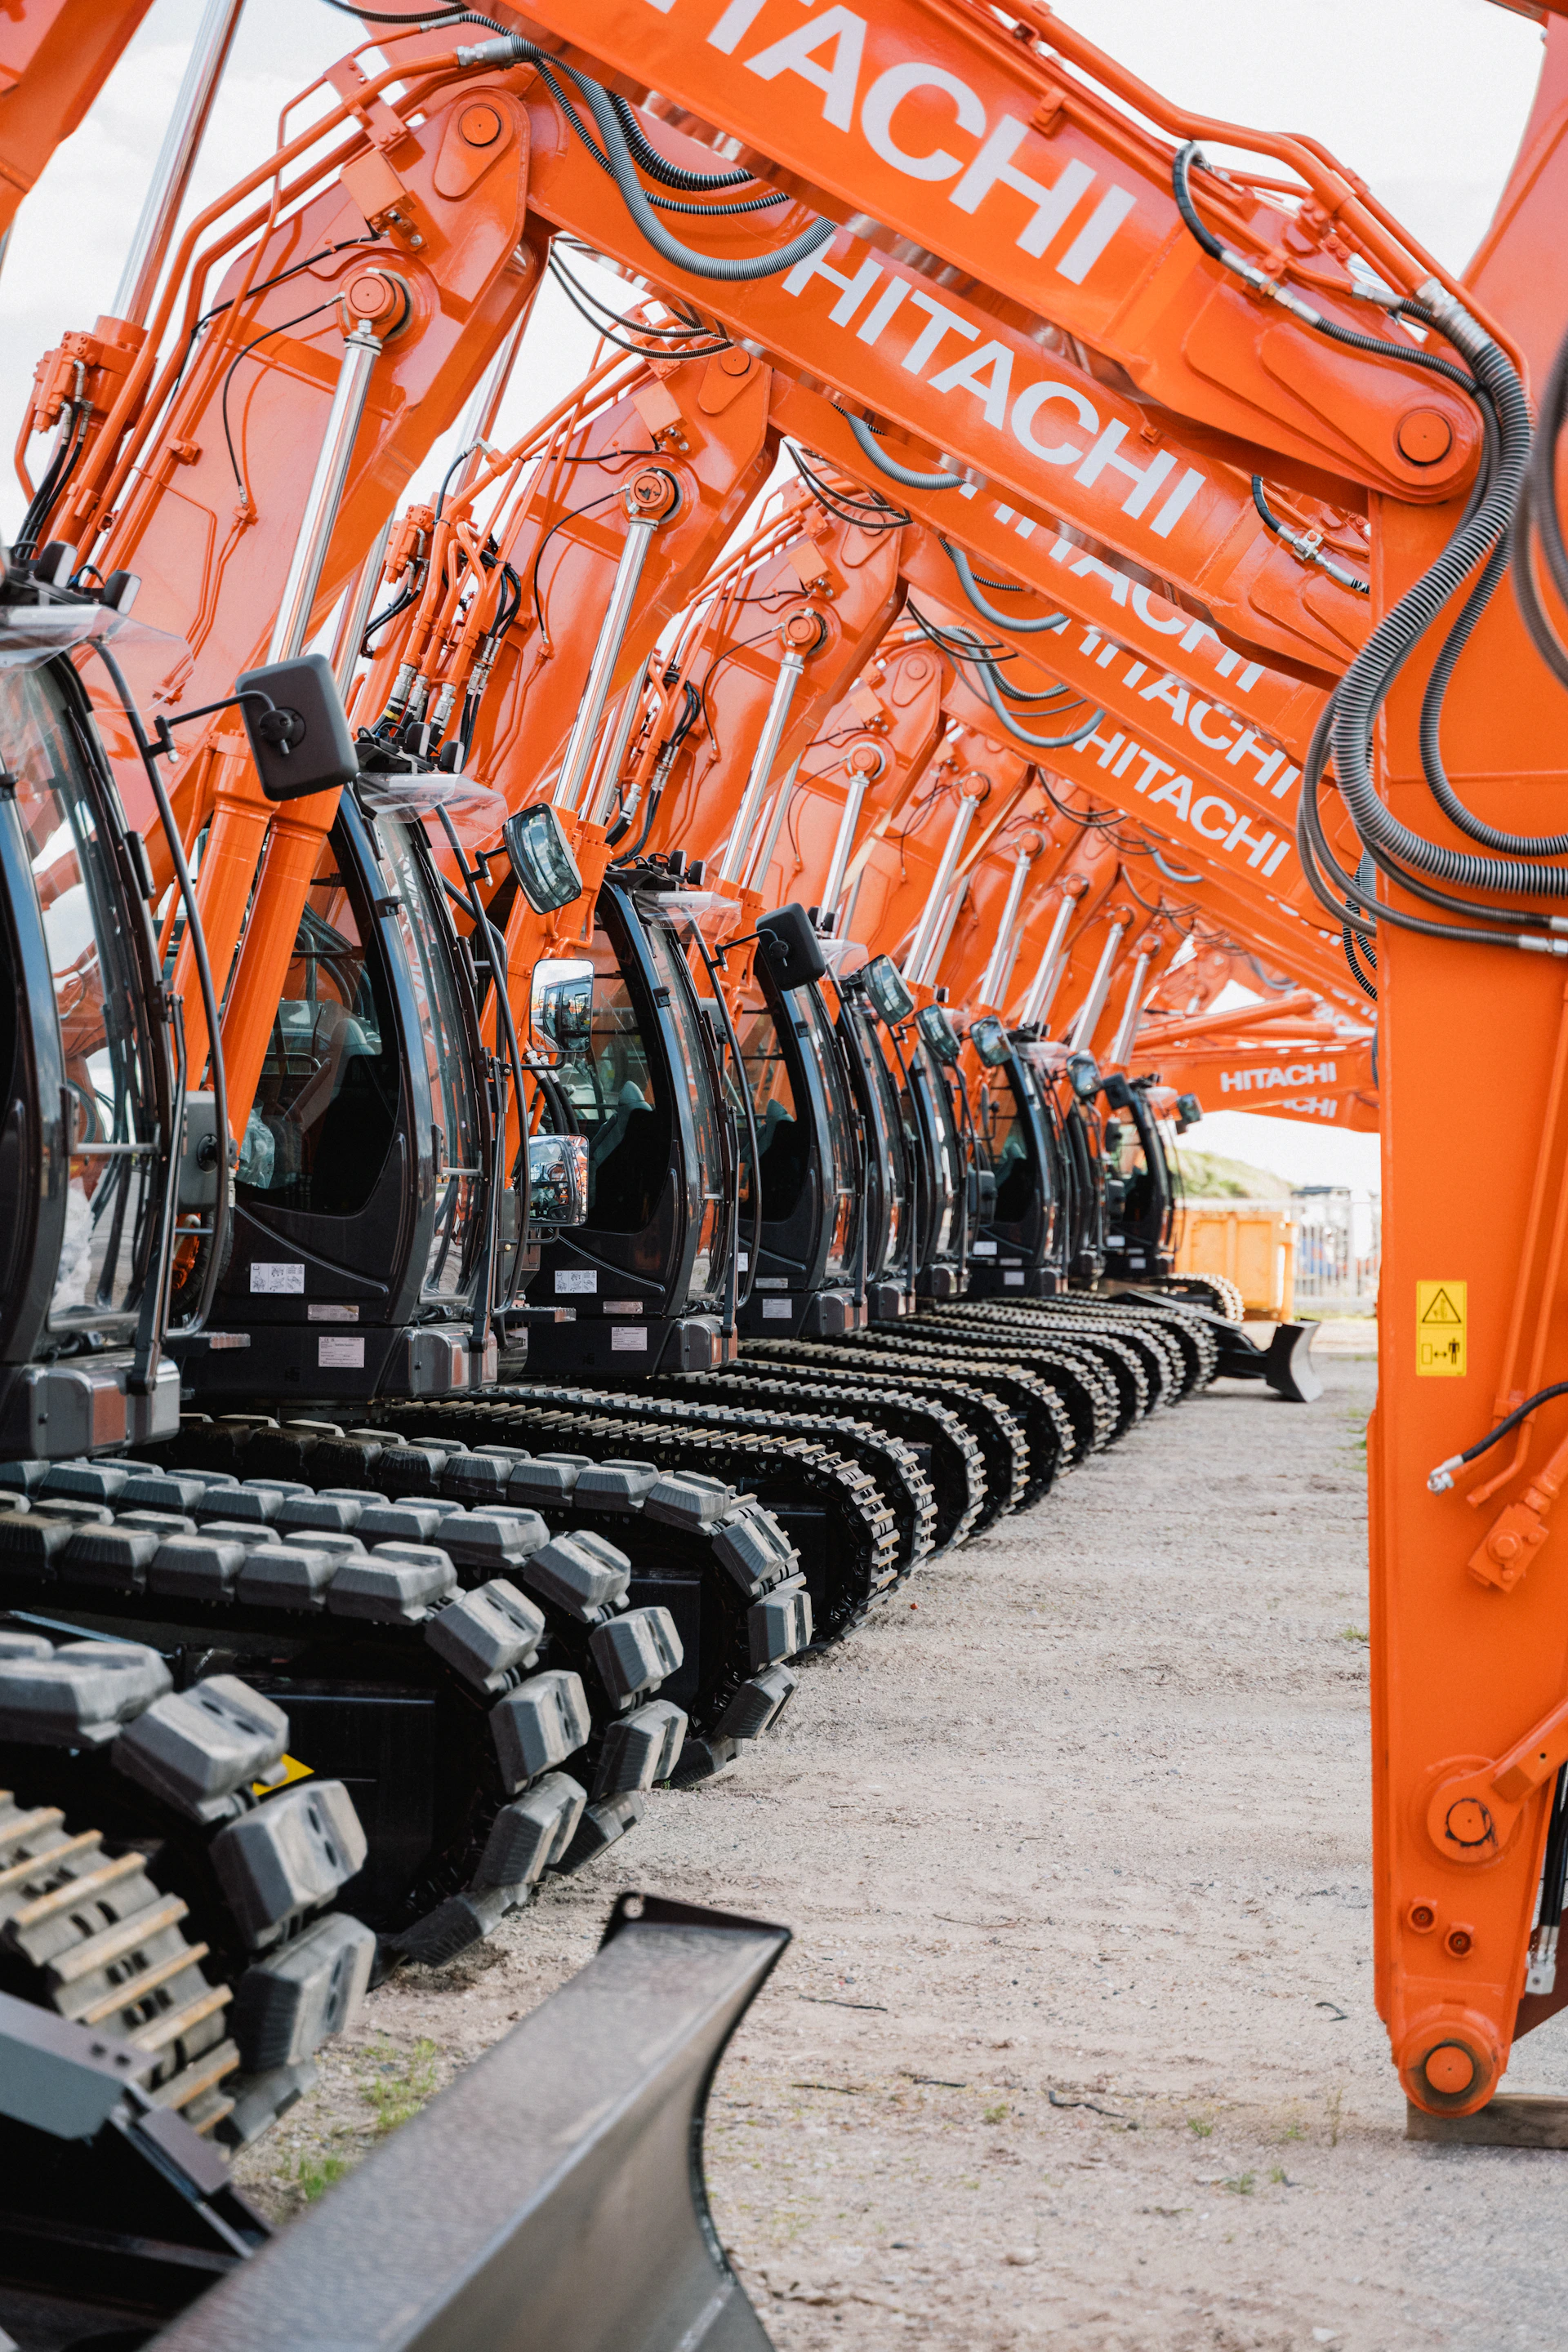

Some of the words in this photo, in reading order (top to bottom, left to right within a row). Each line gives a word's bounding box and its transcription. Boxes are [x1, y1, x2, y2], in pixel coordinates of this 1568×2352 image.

[781, 236, 1205, 538] HITACHI
[1072, 725, 1291, 877] HITACHI
[1220, 1062, 1337, 1092] HITACHI
